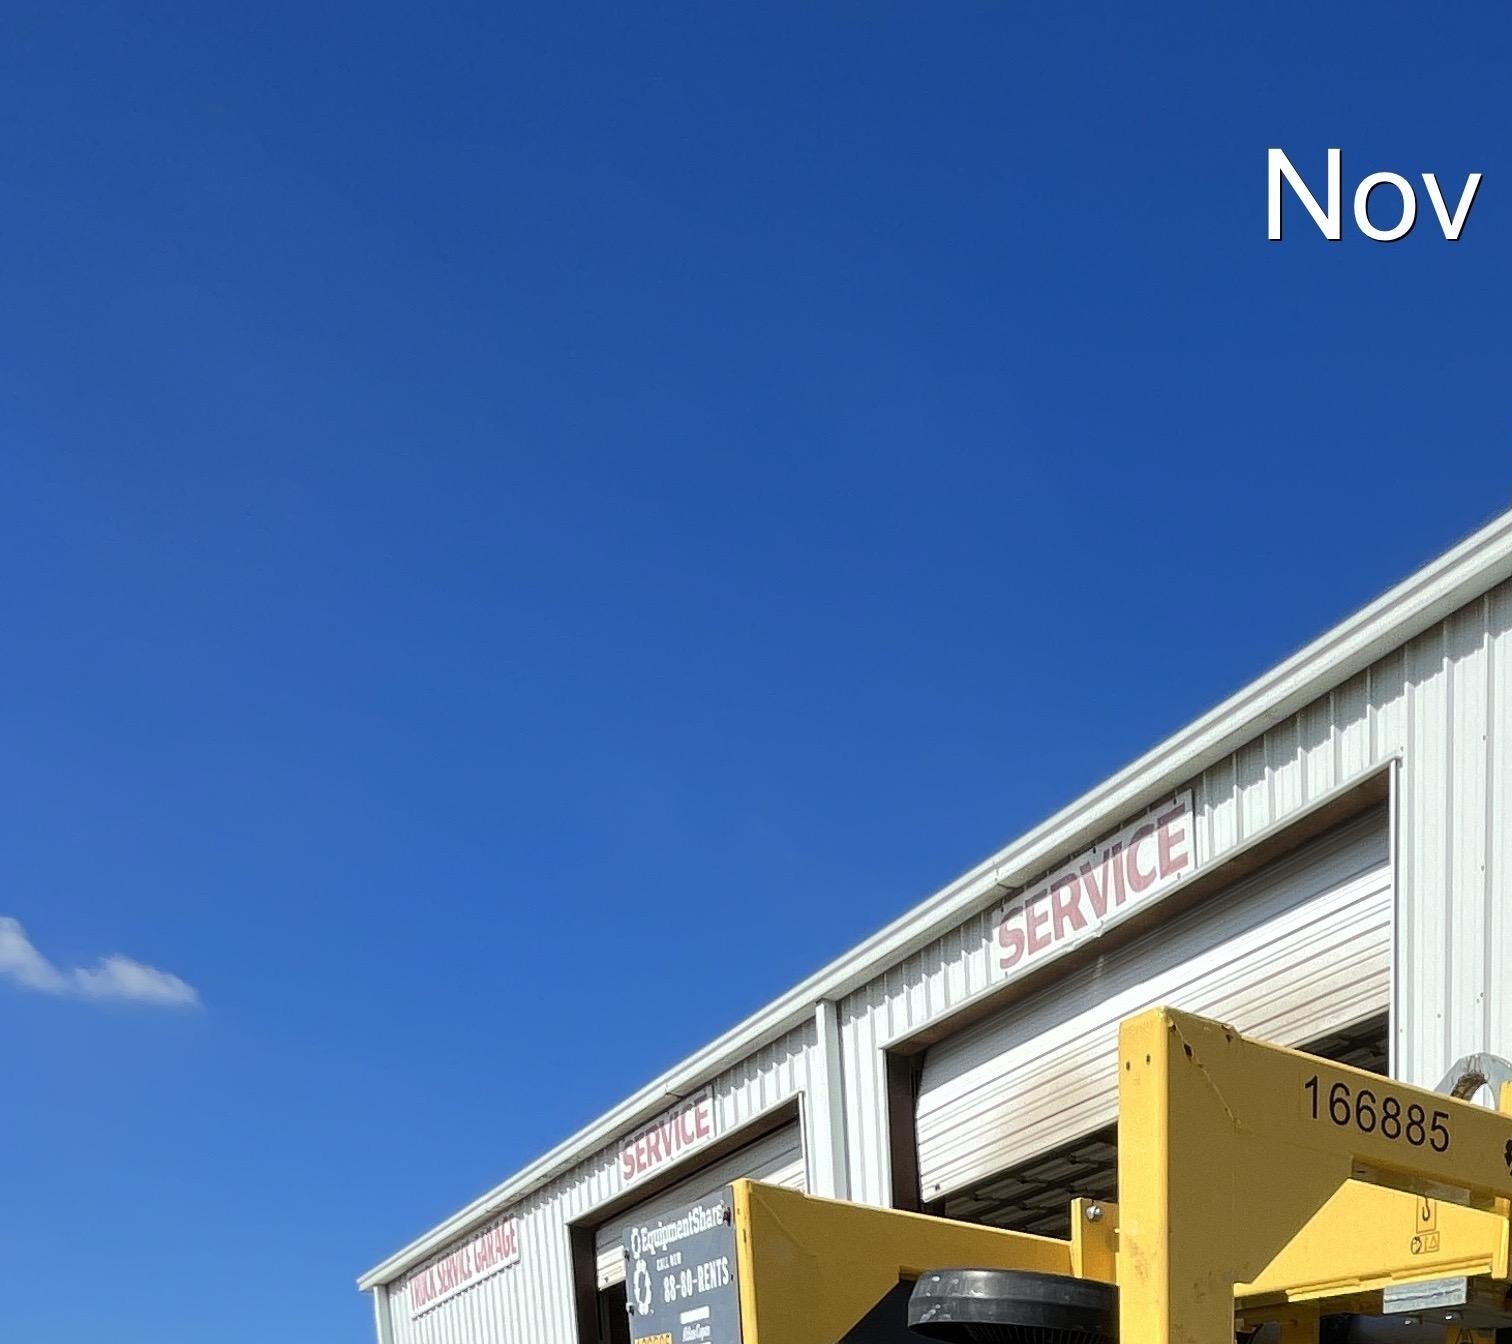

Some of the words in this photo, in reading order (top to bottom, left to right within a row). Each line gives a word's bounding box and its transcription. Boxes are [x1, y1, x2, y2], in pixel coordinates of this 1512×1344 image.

[998, 803, 1190, 970] SERVICE
[622, 1092, 710, 1181] SERVICE
[1304, 1074, 1450, 1153] 166885
[437, 1240, 473, 1296] SERVICE
[474, 1213, 517, 1274] GARAGE
[640, 1203, 724, 1256] EquipmentShare
[663, 1255, 729, 1303] 88-80-RENTS
